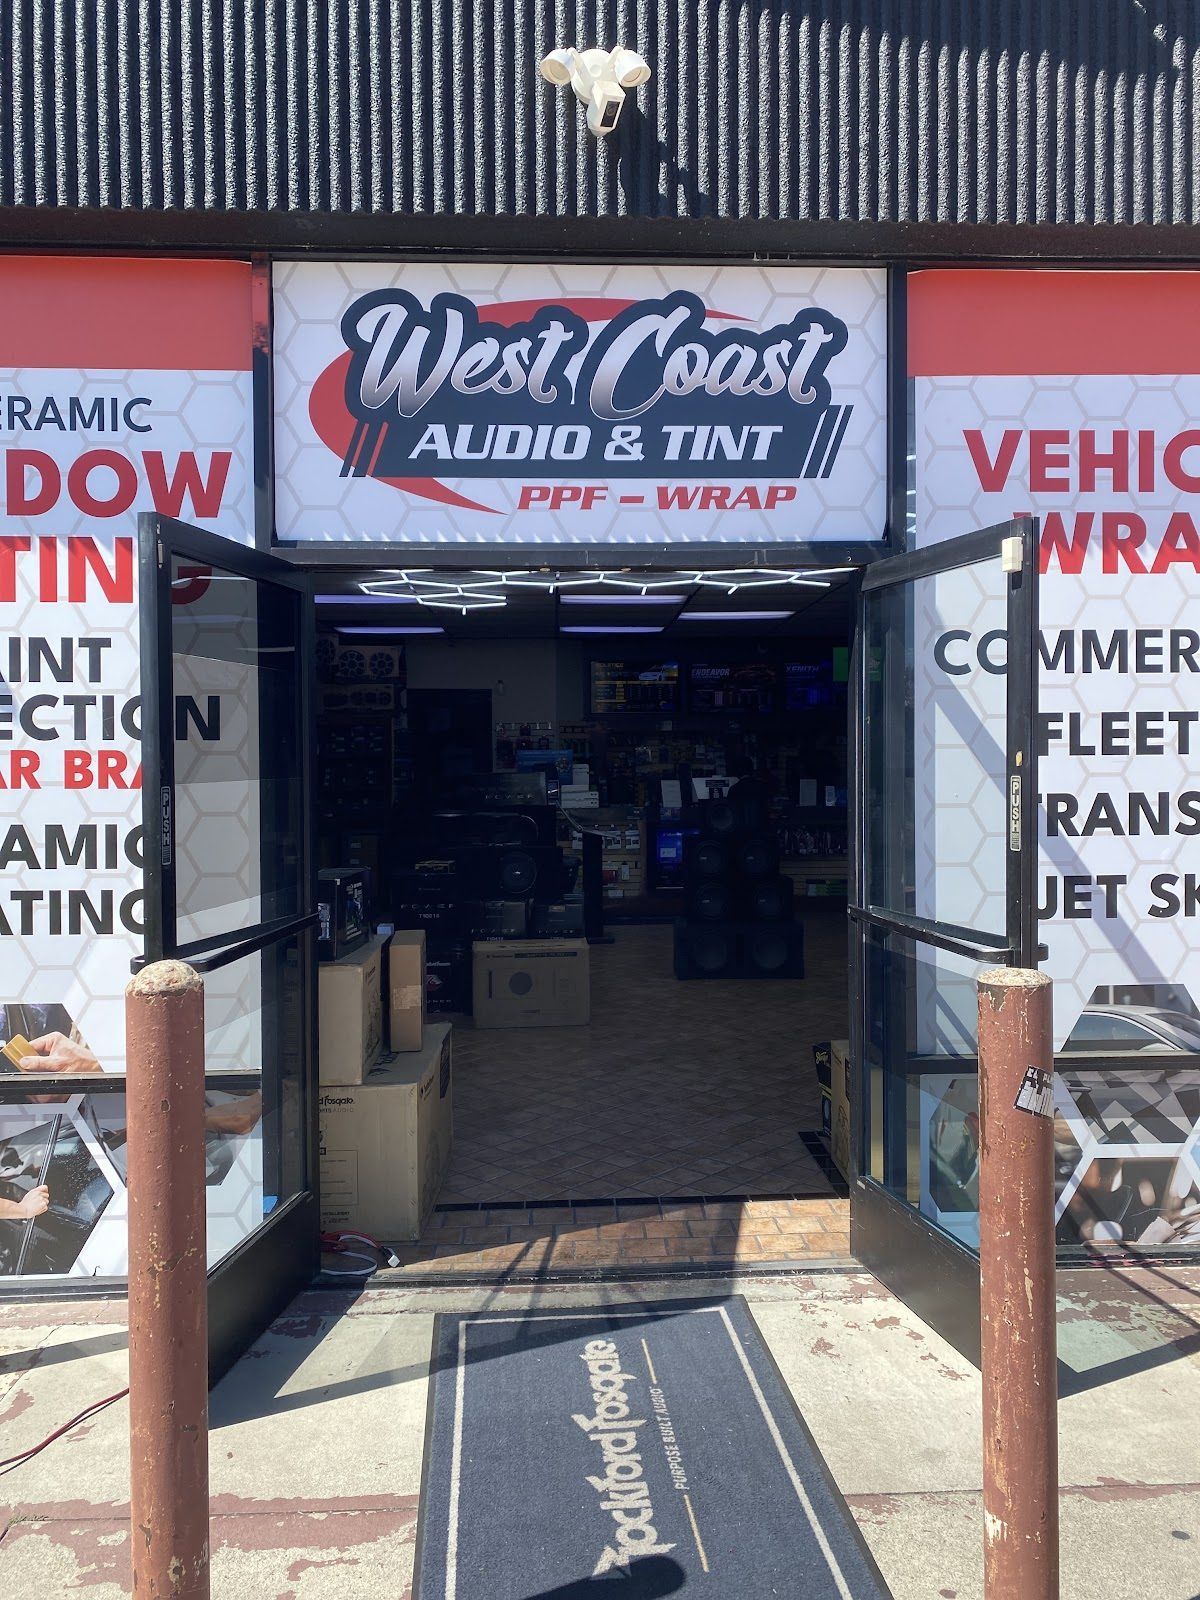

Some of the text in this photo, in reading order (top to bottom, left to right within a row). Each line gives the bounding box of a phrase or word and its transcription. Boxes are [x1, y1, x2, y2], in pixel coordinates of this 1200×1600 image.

[355, 302, 835, 421] West Coast
[0, 395, 152, 433] RAMIC
[408, 423, 783, 461] AUDIO & TINT
[963, 429, 1200, 493] VEHIC
[517, 485, 609, 511] PPF
[657, 485, 797, 511] WRAP
[0, 636, 112, 683] INT
[933, 628, 1200, 676] COMMER
[1038, 711, 1199, 757] FLEET
[0, 749, 142, 790] R BR
[162, 792, 170, 846] PUSH
[1011, 781, 1020, 833] PUSH
[1037, 790, 1200, 836] RANS
[1038, 874, 1127, 920] JET
[649, 1387, 690, 1490] PURPOSE BUILT AUDIO
